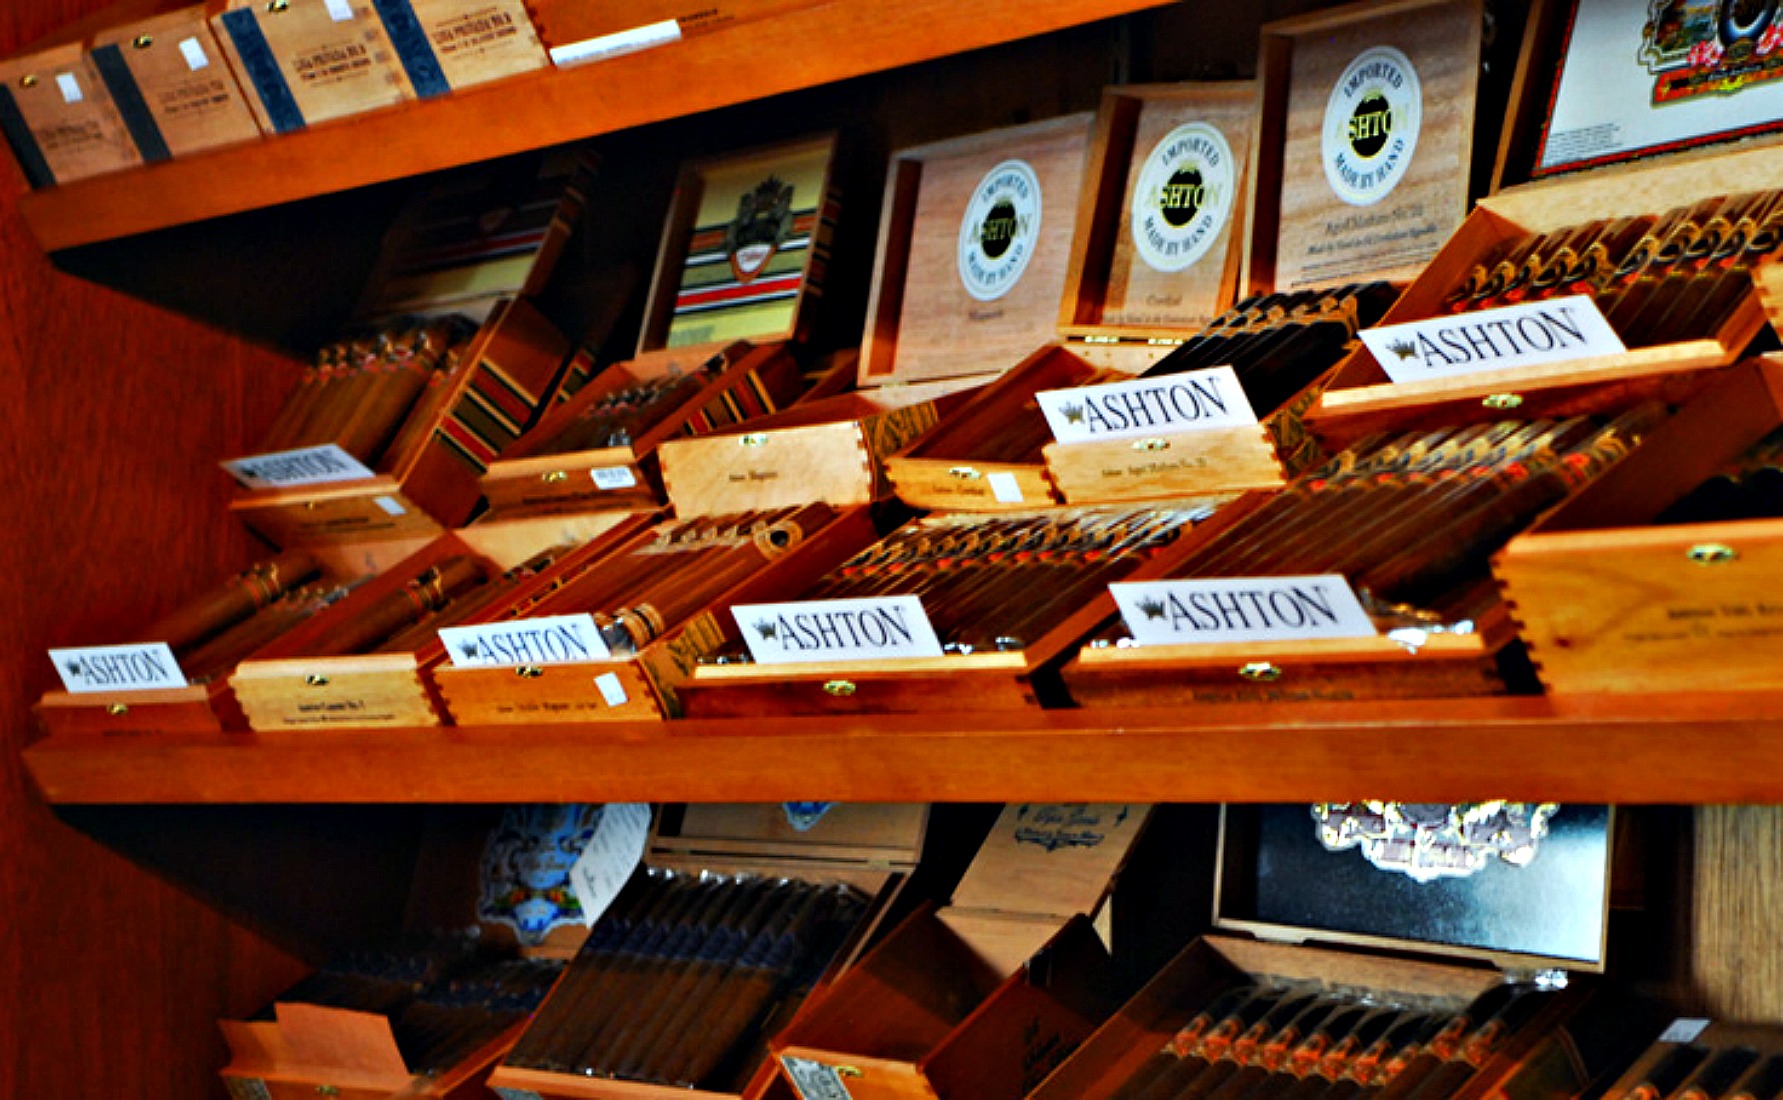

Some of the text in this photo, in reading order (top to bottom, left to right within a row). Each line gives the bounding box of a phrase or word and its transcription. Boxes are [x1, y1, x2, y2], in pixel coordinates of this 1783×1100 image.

[1344, 62, 1403, 97] IMPORTED
[1162, 138, 1219, 167] IMPORTED
[1335, 139, 1404, 189] MADE BY HAND
[982, 174, 1028, 201] IMPORTED
[1144, 216, 1164, 254] MADE
[1182, 214, 1212, 253] HAND
[1416, 307, 1587, 367] ASHTON
[1085, 376, 1227, 433] ASHTON
[252, 450, 349, 480] ASHTON
[777, 605, 913, 650] ASHTON
[1168, 586, 1338, 631] ASHTON
[477, 623, 590, 664] ASHTON
[79, 649, 168, 685] ASHTON
